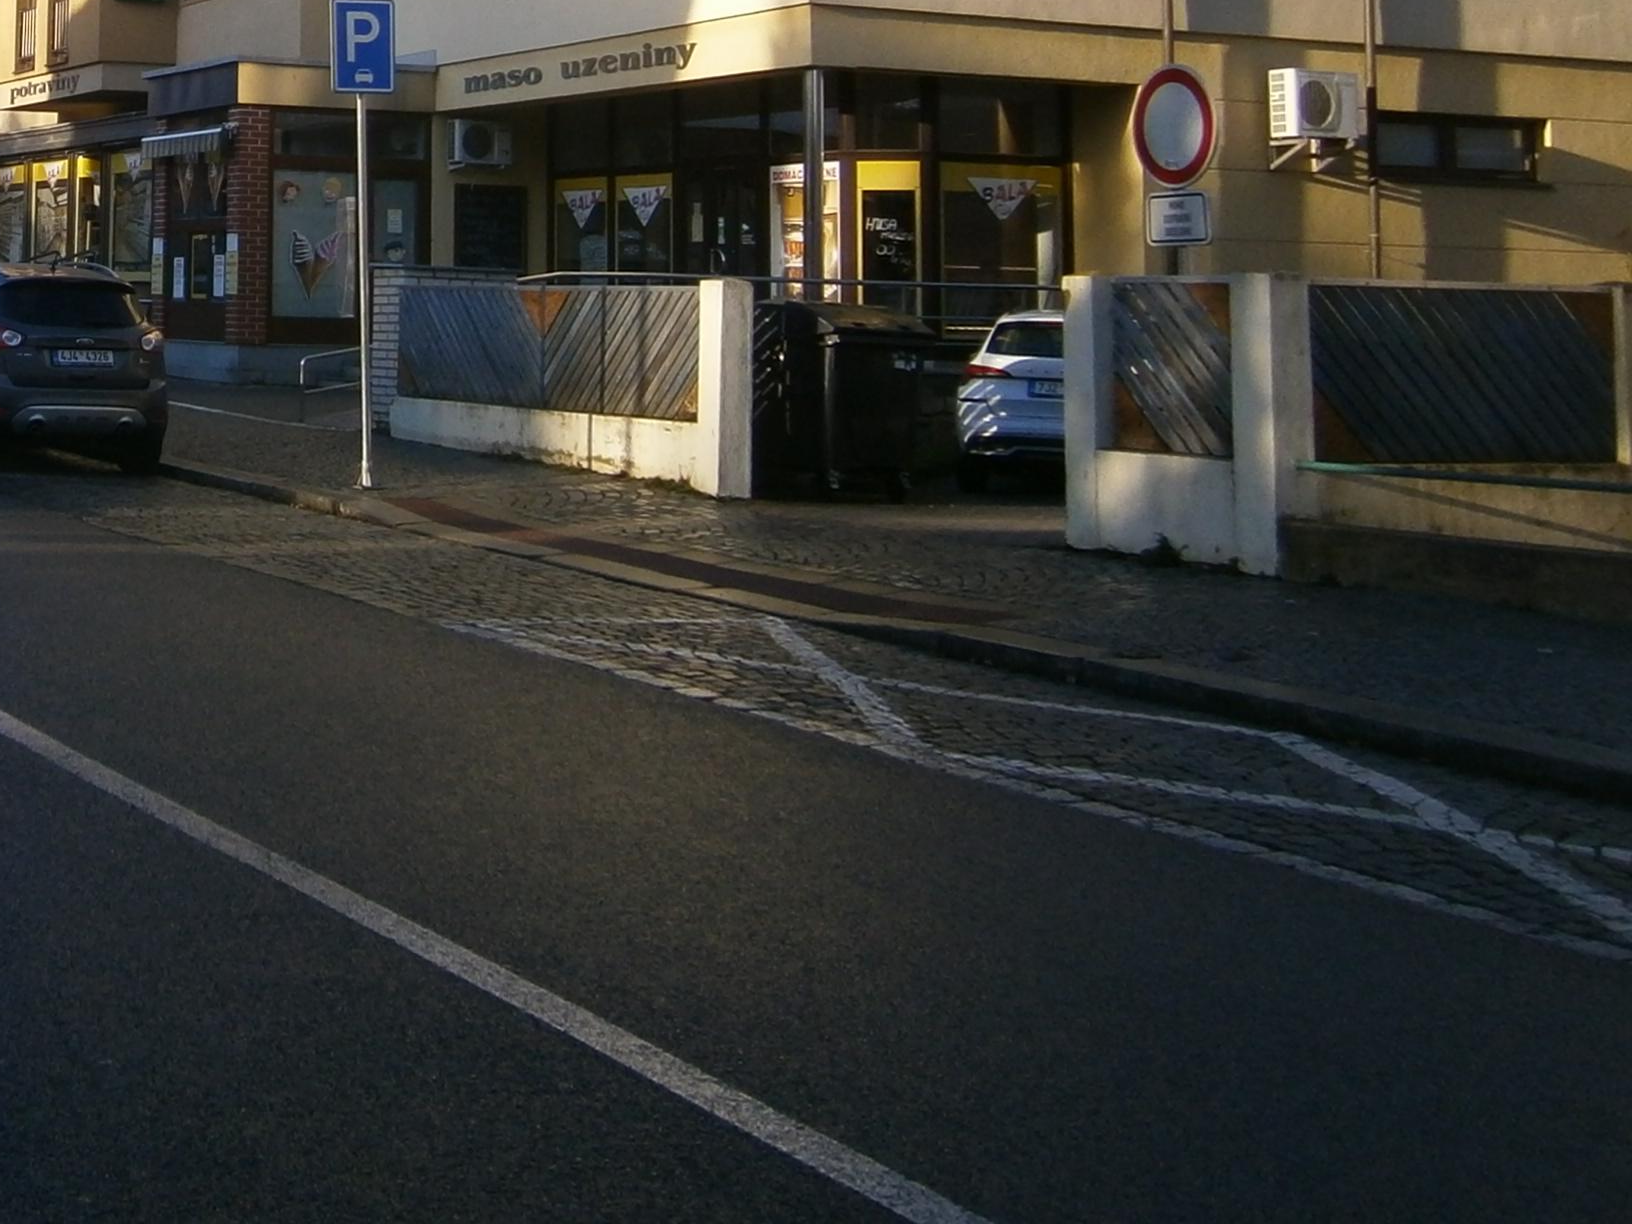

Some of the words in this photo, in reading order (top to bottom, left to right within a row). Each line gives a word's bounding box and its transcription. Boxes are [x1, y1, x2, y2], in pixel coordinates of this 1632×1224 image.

[346, 10, 380, 63] P
[10, 73, 80, 105] potraviny
[464, 66, 543, 94] maso
[560, 42, 697, 80] uzeniny
